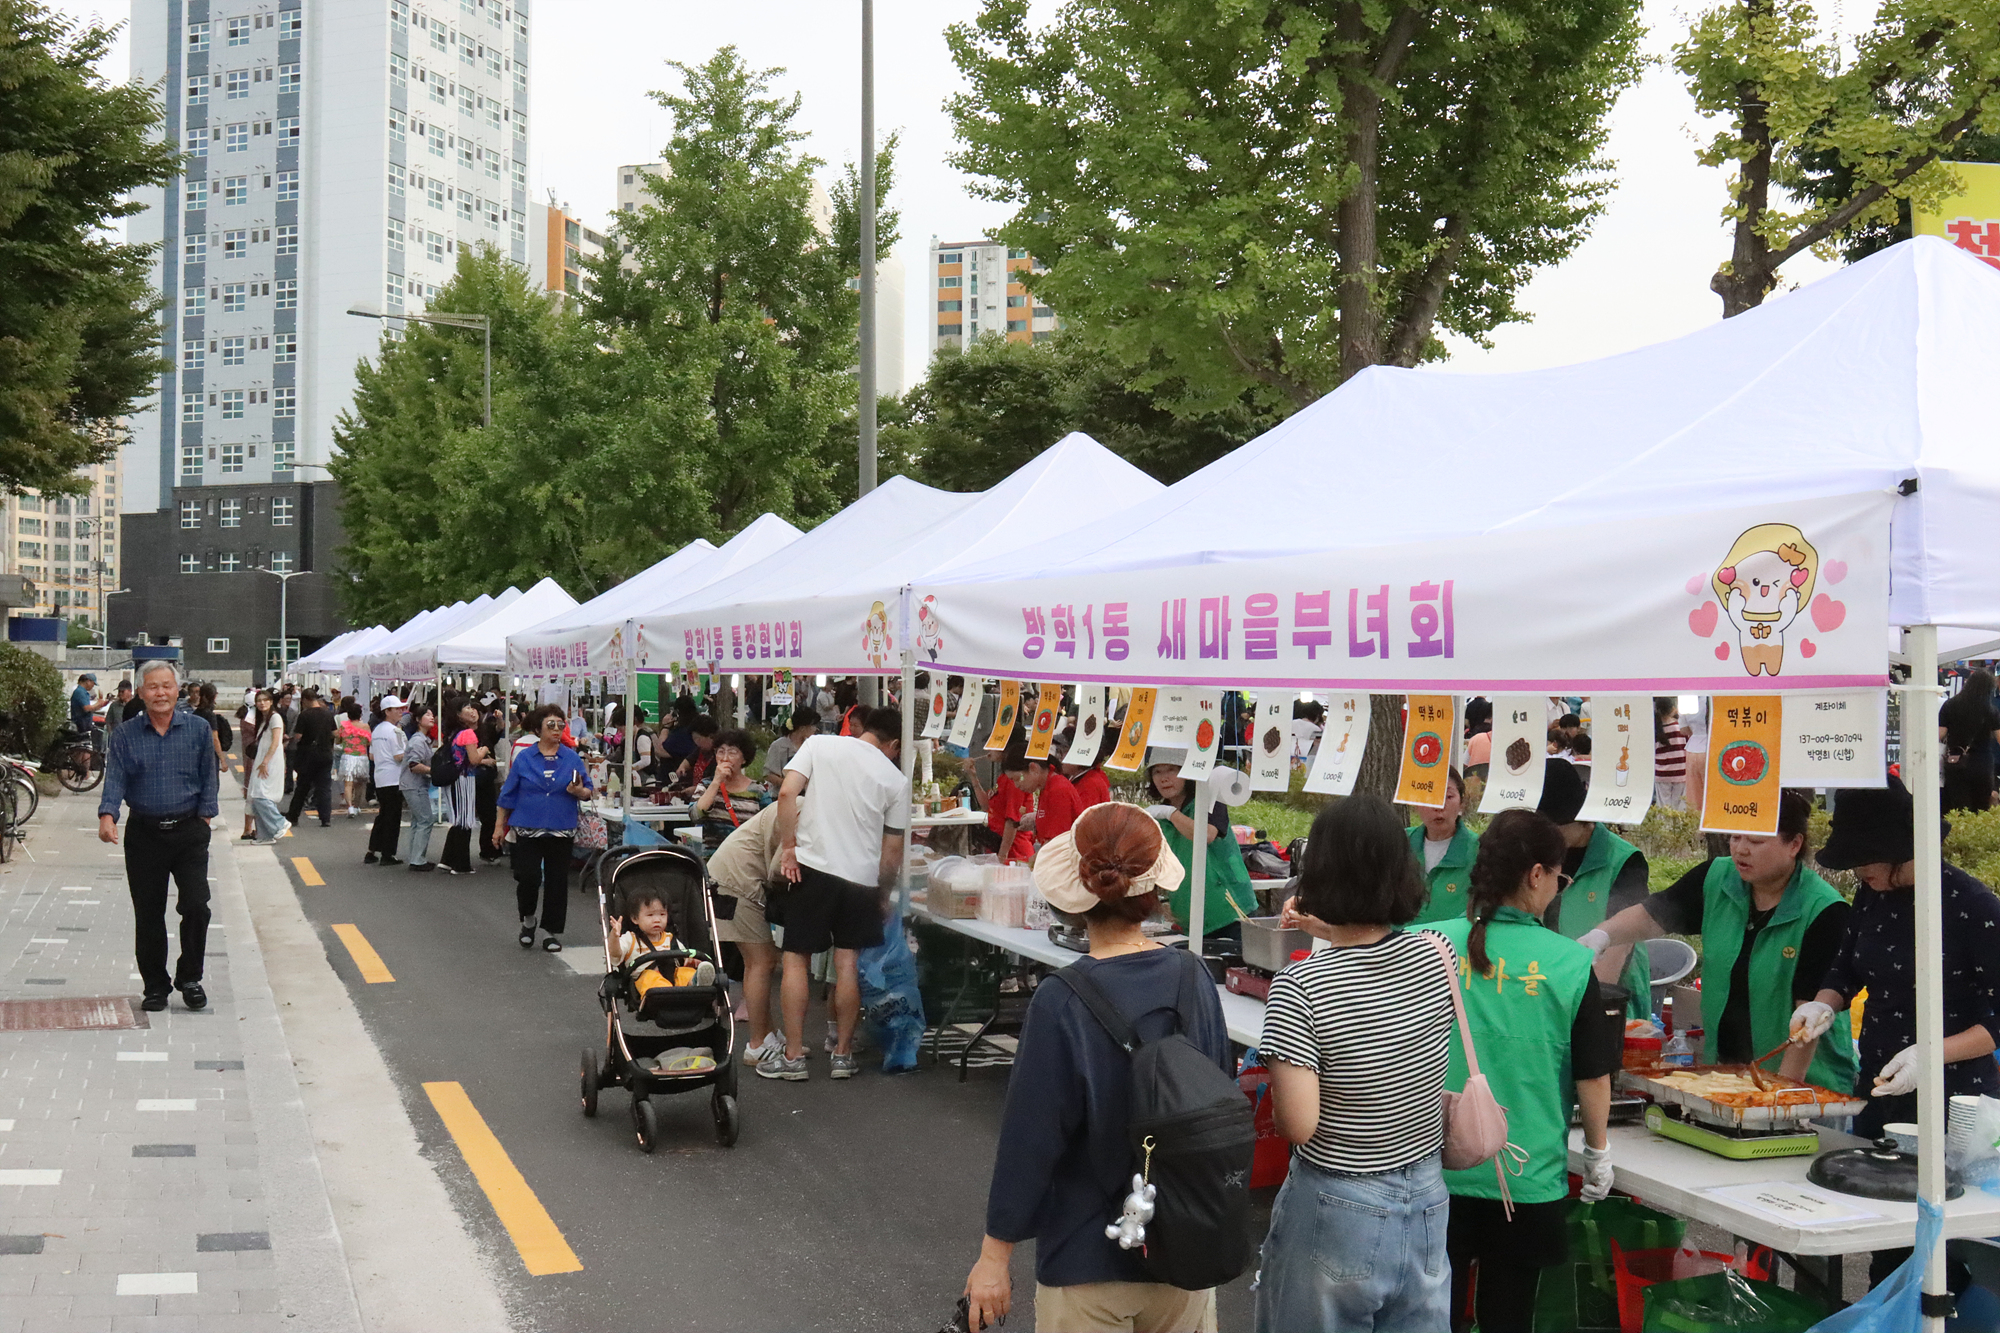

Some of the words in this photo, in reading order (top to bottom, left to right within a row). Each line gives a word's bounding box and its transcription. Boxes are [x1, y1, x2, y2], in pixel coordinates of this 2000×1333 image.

[1021, 601, 1130, 662] 방학1동
[1156, 579, 1456, 661] 새마을부녀회
[683, 627, 724, 660] 방학1동
[731, 620, 802, 660] 통장협의회
[1614, 703, 1631, 720] 어묵
[1814, 701, 1847, 711] 계좌이체
[1417, 705, 1444, 723] 떡볶이
[1511, 709, 1528, 724] 순대
[1727, 706, 1767, 728] 떡볶이
[1799, 733, 1862, 744] 137-009-807094
[1807, 749, 1830, 761] 박명희
[1833, 749, 1855, 761] (신협)
[1261, 768, 1279, 780] 4,000원
[1323, 771, 1344, 783] 1,000원
[1411, 780, 1434, 793] 4,000원
[1499, 788, 1526, 802] 4,000원
[1604, 796, 1632, 809] 1,000원
[1723, 802, 1758, 817] 4,000원
